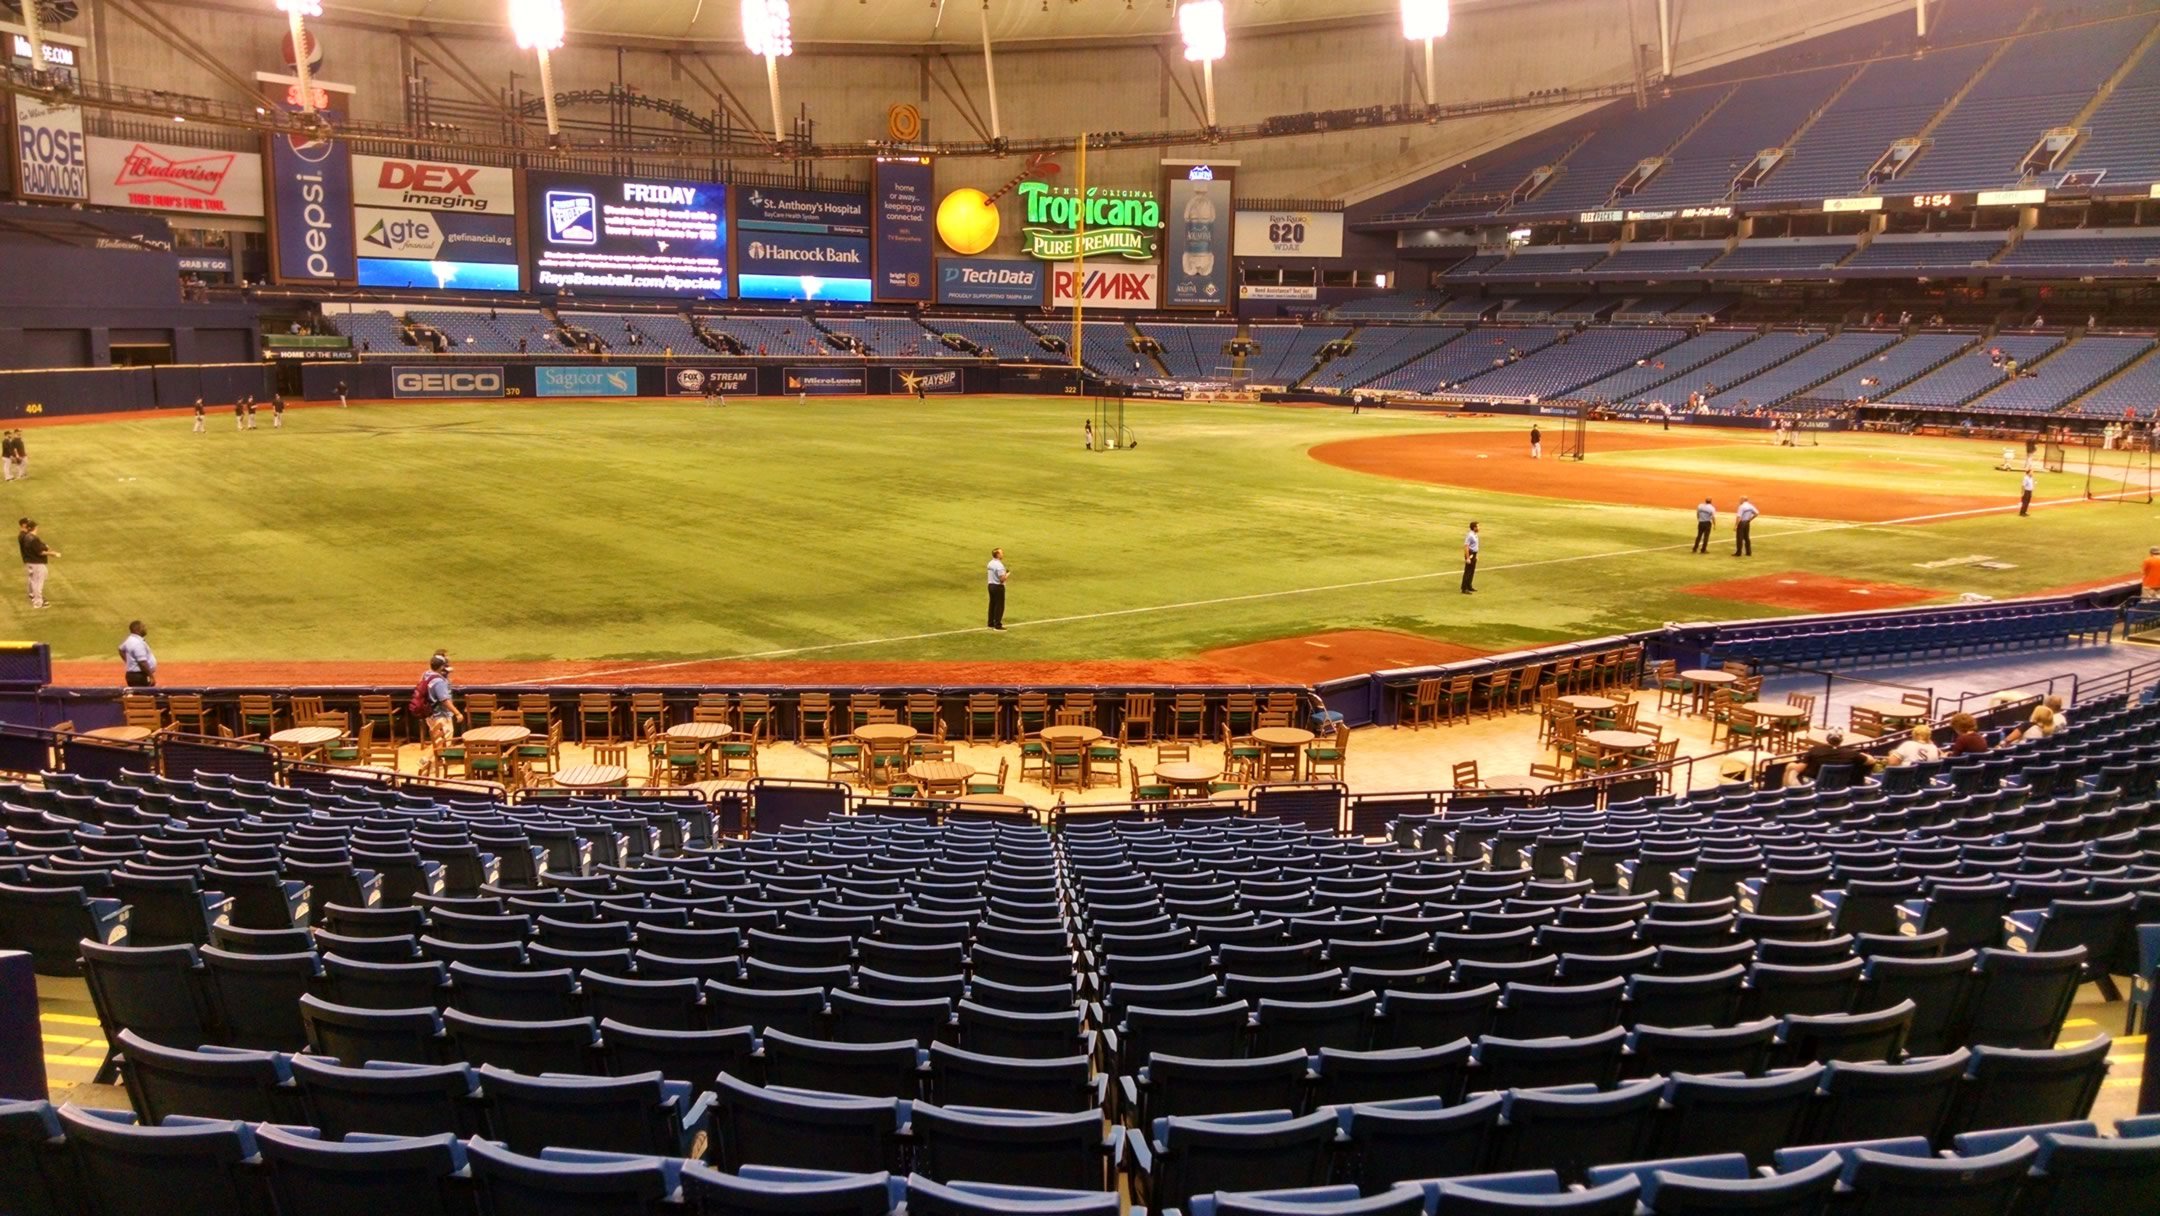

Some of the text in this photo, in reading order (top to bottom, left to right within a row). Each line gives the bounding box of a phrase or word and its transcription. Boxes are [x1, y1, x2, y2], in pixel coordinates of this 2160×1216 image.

[20, 124, 84, 168] ROSE
[125, 152, 224, 183] Budweiser
[23, 162, 84, 198] RADIOLOGY
[378, 161, 480, 196] DEX
[623, 183, 697, 206] FRIDAY
[894, 183, 915, 193] home
[1102, 189, 1154, 200] ORIGINAL
[129, 193, 227, 212] THIS BUD'S FOR YOU.
[402, 191, 488, 211] imaging
[890, 193, 898, 202] or
[1912, 195, 1951, 208] 5:54
[764, 198, 861, 217] St. Anthony's Hospital
[884, 201, 926, 215] keeping you
[1018, 182, 1160, 230] Tropicana
[886, 212, 924, 223] connected.
[1580, 212, 1596, 223] FLEX
[297, 174, 335, 277] pepsi
[390, 219, 430, 243] gte
[448, 233, 513, 247] gtefinancial.org
[1269, 223, 1305, 244] 620
[398, 241, 436, 252] financial
[1033, 234, 1142, 256] PURE PREMIUM
[1273, 244, 1301, 252] WDAE
[766, 245, 862, 264] Hancock Bank
[179, 259, 202, 269] GRAB
[212, 261, 227, 270] GO!
[539, 270, 722, 293] RaysBaseball.com/Specials
[1055, 271, 1151, 301] RE/MAX
[948, 292, 972, 300] PROUDLY
[973, 293, 1004, 301] SUPPORTING
[280, 351, 353, 361] HOME OF THE RAYS
[397, 373, 501, 393] GEICO
[545, 369, 604, 390] Sagicor
[683, 373, 699, 381] FOX
[709, 372, 748, 382] STREAM
[803, 377, 862, 386] MicroLumen
[505, 388, 521, 397] 370
[1064, 386, 1078, 395] 322
[26, 403, 43, 415] 404
